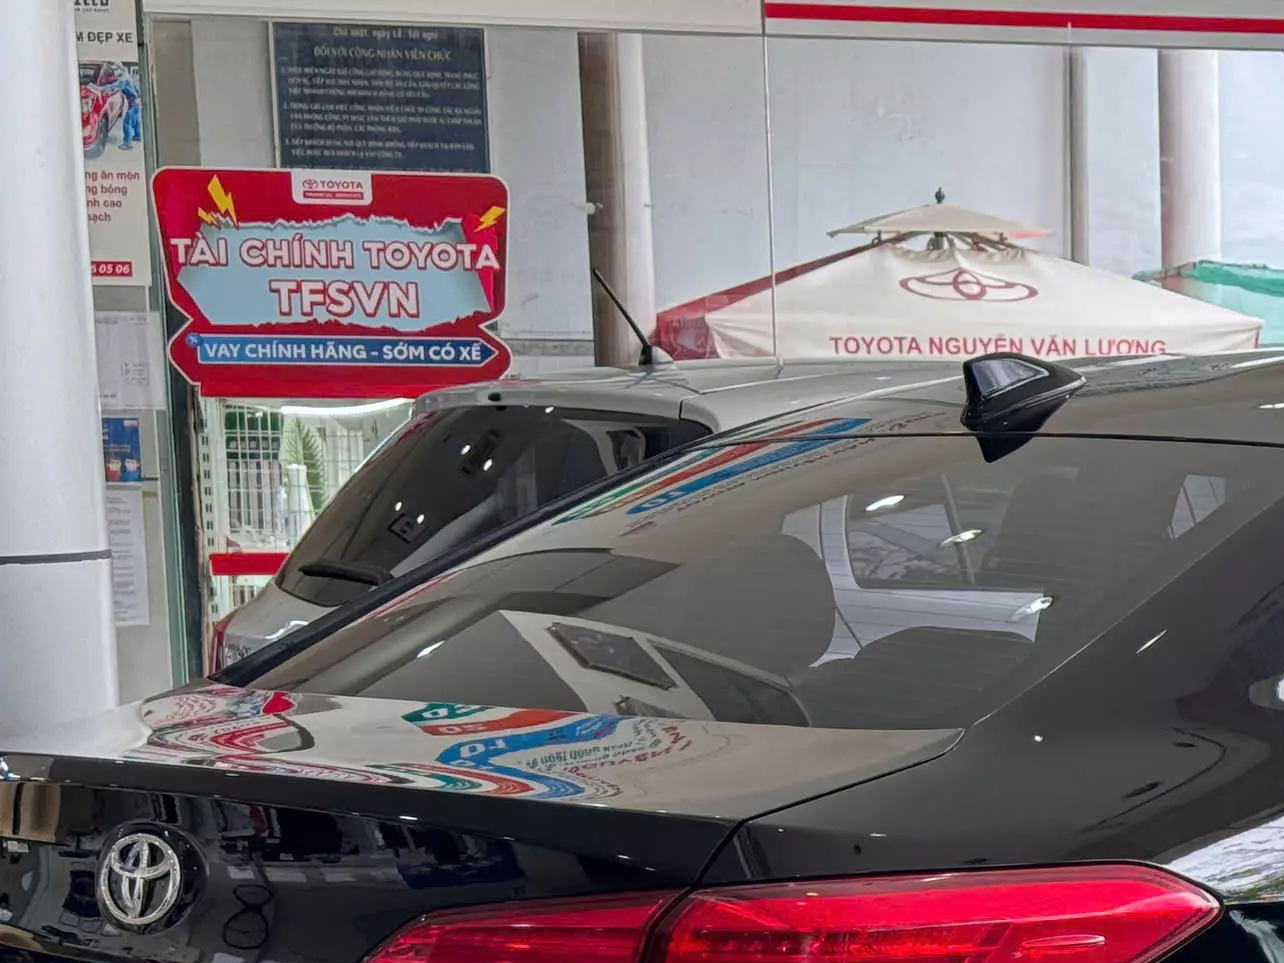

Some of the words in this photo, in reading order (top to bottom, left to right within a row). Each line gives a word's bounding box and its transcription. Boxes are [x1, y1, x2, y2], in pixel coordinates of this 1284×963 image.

[87, 31, 113, 45] ĐẸP
[116, 32, 133, 43] XE
[349, 46, 376, 59] CÔNG
[377, 47, 403, 60] NHÂN
[101, 169, 114, 180] ăn
[116, 170, 140, 180] mòn
[101, 184, 128, 196] bóng
[320, 180, 364, 189] TOYOTA
[103, 199, 122, 208] cao
[170, 231, 229, 267] TÀI
[239, 232, 355, 269] CHÍNH
[362, 240, 501, 271] TOYOTA
[99, 264, 113, 274] 05
[115, 264, 130, 274] 06
[268, 279, 420, 318] TFSVN
[204, 343, 241, 359] VAY
[245, 340, 307, 360] CHÍNH
[311, 340, 368, 360] HÃNG
[382, 341, 425, 360] SỚM
[428, 342, 456, 361] CÓ
[829, 336, 922, 355] TOYOTA
[928, 333, 1024, 355] NGUYỄN
[1031, 335, 1077, 356] VĂN
[1085, 338, 1167, 356] LƯƠNG
